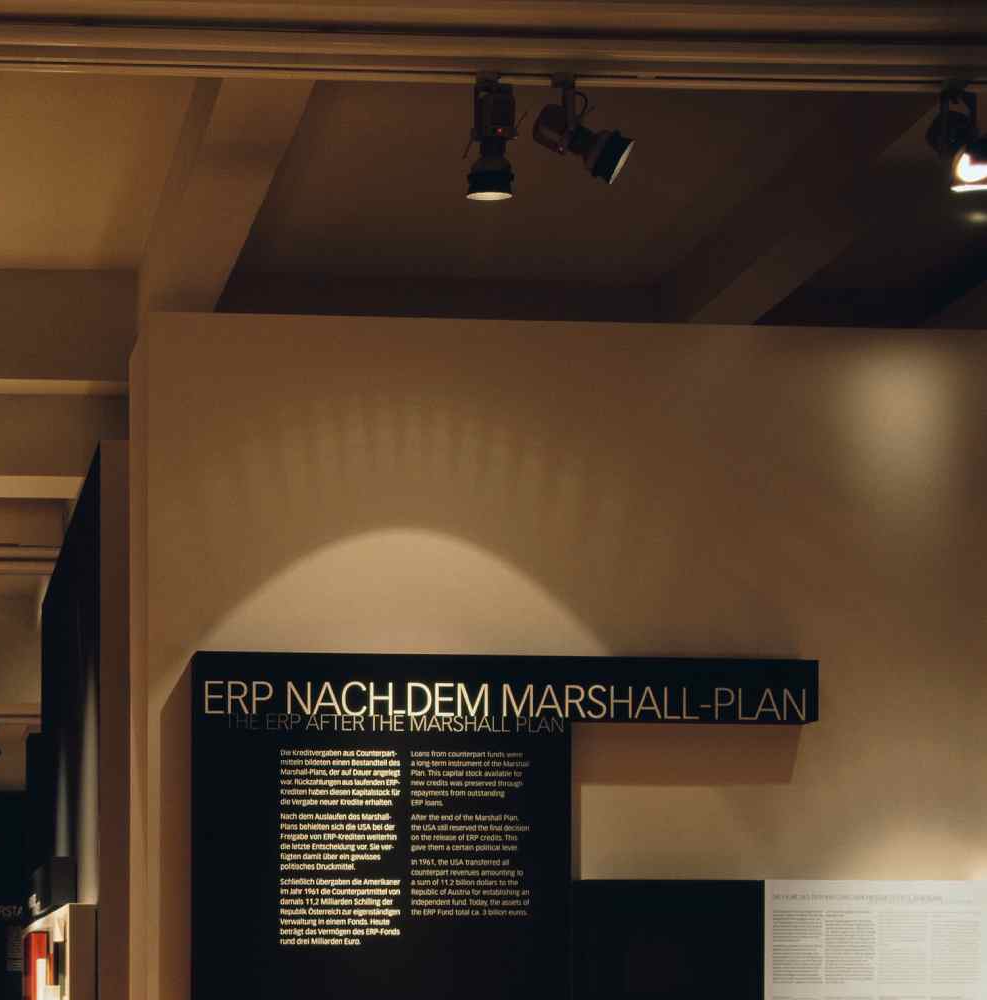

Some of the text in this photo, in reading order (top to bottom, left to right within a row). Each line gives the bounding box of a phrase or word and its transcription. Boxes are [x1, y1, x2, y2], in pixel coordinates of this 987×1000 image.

[204, 681, 273, 714] ERP
[503, 683, 806, 720] MARSHALL-PLAN
[266, 713, 301, 730] ERP
[305, 714, 364, 731] AFTER
[371, 714, 404, 732] THE
[410, 715, 510, 733] MARSHALL
[517, 716, 564, 733] PLAN
